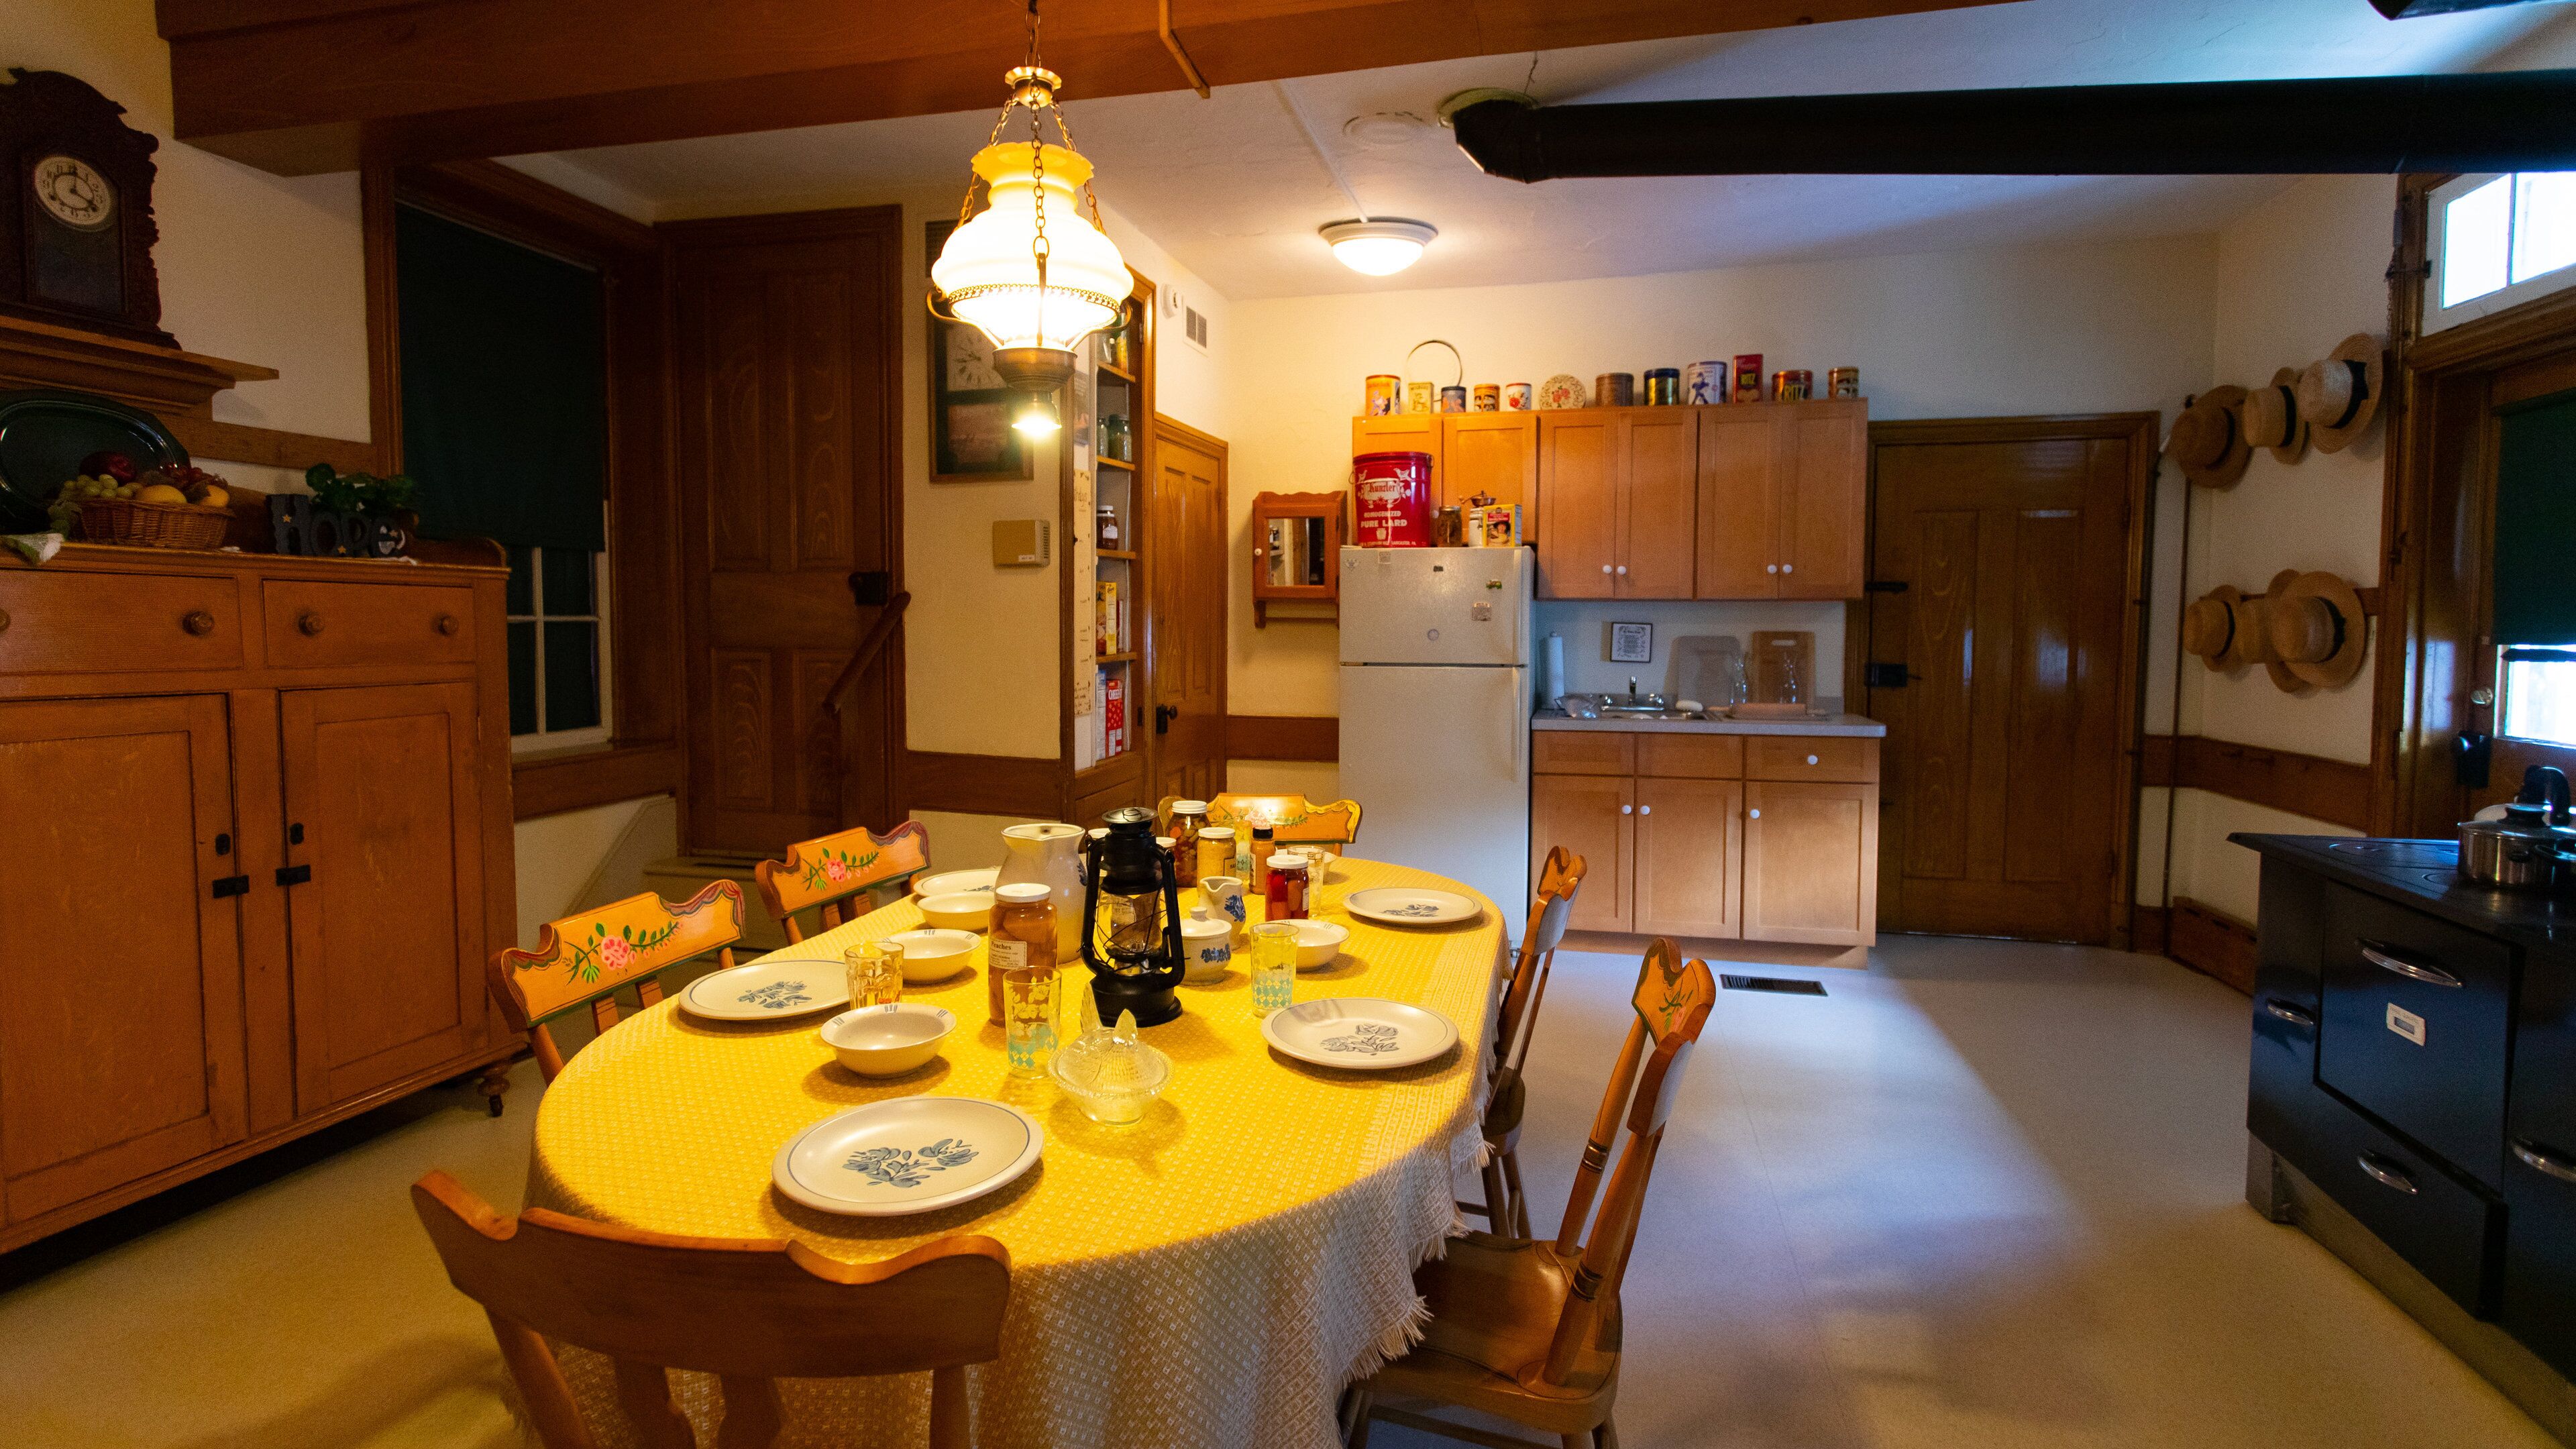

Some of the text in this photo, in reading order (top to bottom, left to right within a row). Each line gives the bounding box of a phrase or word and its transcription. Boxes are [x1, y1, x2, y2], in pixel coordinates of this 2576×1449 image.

[1784, 384, 1805, 401] RITZ
[1369, 482, 1395, 492] Kunzler
[991, 941, 1011, 949] Peaches
